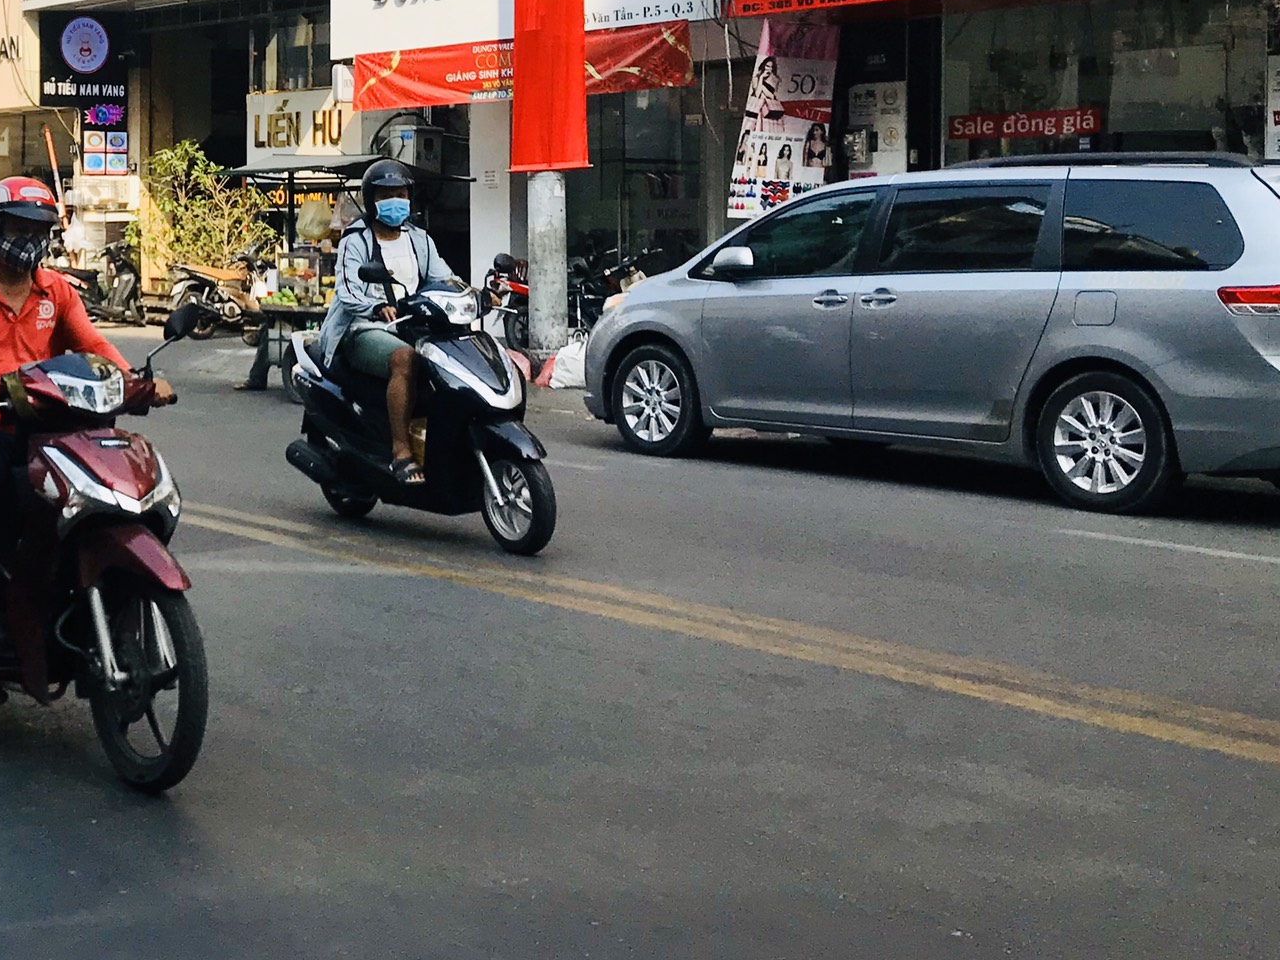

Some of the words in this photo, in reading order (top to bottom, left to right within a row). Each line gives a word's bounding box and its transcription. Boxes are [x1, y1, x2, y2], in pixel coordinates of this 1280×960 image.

[643, 5, 661, 18] P.5
[671, 1, 694, 17] Q.3
[445, 70, 477, 82] GIÁNG
[478, 69, 499, 80] SINH
[57, 75, 77, 95] TIẾU
[80, 84, 99, 96] NAM
[102, 84, 125, 97] VANG
[498, 90, 508, 98] TO
[254, 99, 301, 148] LIẾN
[953, 117, 994, 135] Sale
[1003, 112, 1057, 135] đồng
[1062, 110, 1095, 134] giá
